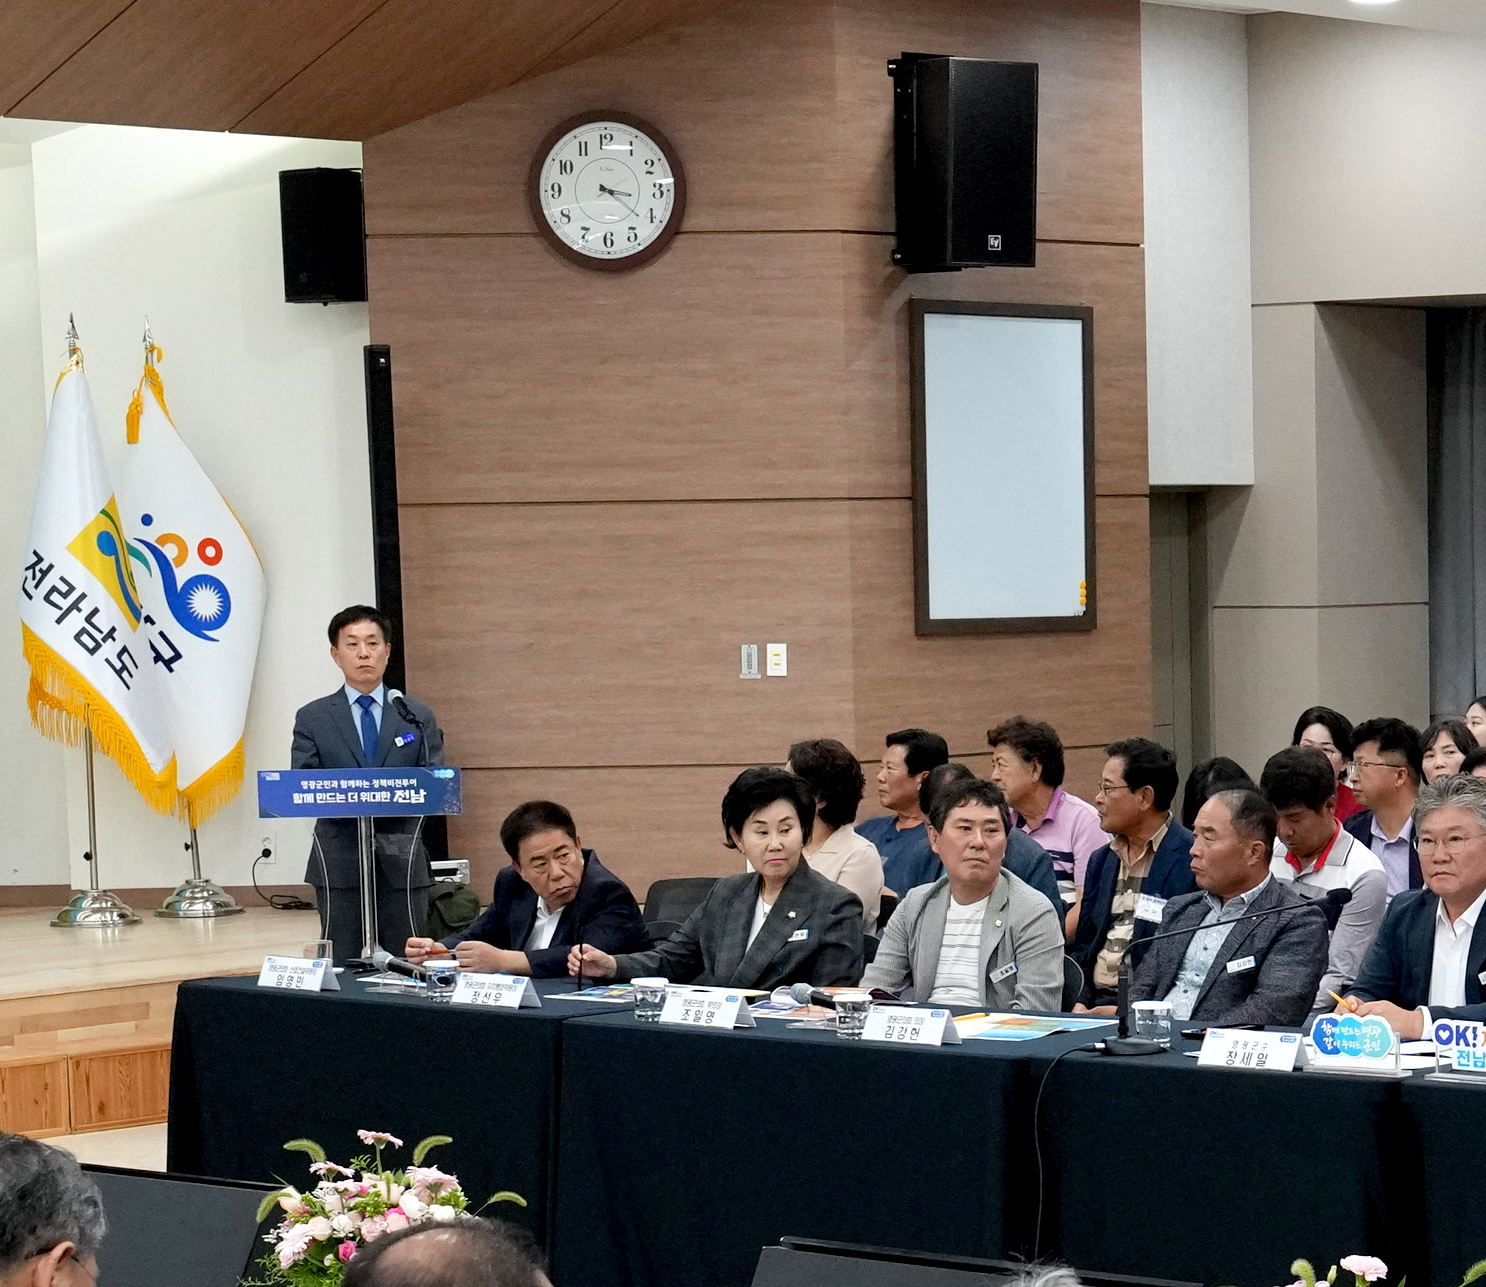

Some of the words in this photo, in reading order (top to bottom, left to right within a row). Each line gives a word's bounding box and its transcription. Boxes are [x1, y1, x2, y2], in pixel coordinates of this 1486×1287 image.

[578, 141, 588, 156] 11
[599, 133, 614, 150] 12
[629, 141, 633, 156] 1
[559, 159, 574, 175] 10
[644, 159, 655, 175] 2
[551, 182, 562, 199] 9
[652, 182, 664, 199] 3
[560, 208, 571, 224] 8
[644, 208, 656, 224] 4
[580, 226, 591, 243] 7
[603, 231, 614, 248] 6
[627, 226, 638, 243] 5
[22, 549, 139, 690] 전라남도
[293, 792, 314, 804] 함께
[316, 792, 349, 804] 만드는
[348, 792, 359, 803] 더
[360, 791, 391, 803] 위대한
[393, 788, 427, 804] 전남
[681, 1008, 716, 1024] 조일영
[1435, 1023, 1478, 1048] OK!
[1226, 1051, 1269, 1067] 장세일
